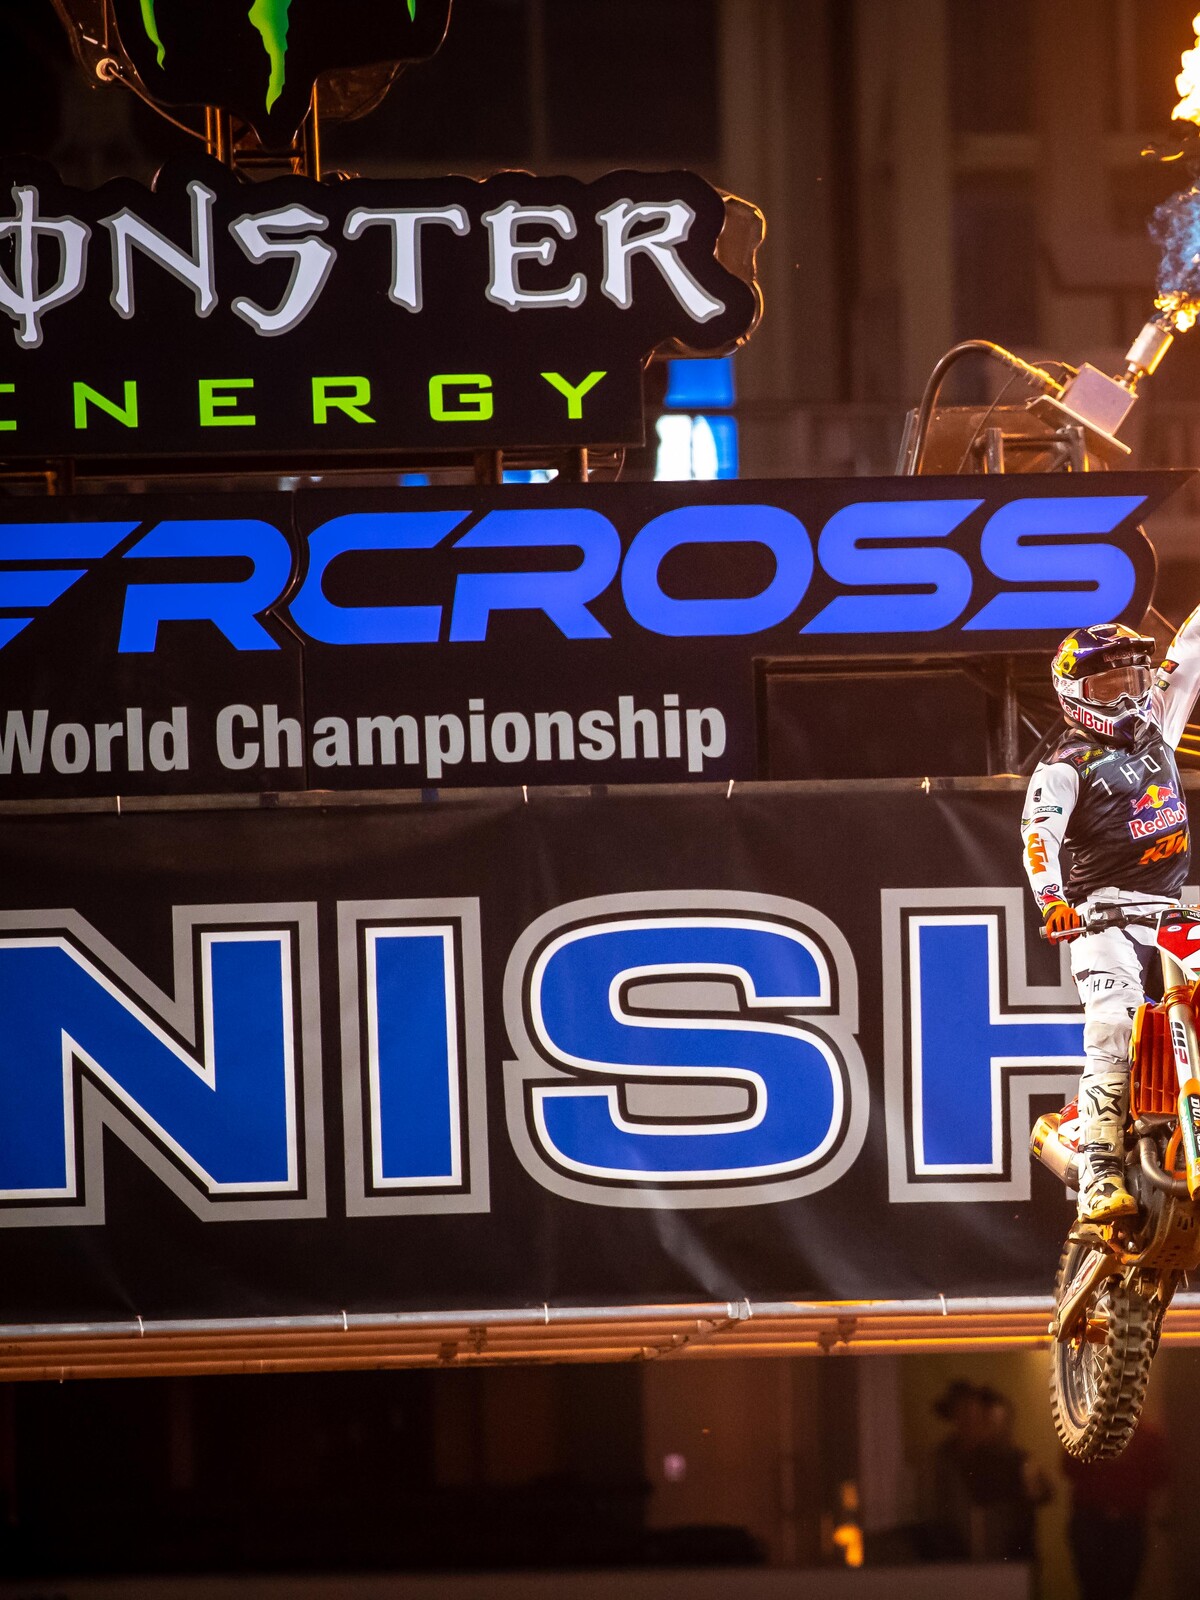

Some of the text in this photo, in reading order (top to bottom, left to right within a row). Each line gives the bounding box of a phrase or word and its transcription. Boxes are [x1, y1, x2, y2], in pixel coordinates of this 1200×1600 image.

[0, 694, 727, 779] World Championship
[1028, 833, 1049, 875] KTM
[1137, 830, 1188, 865] KTM
